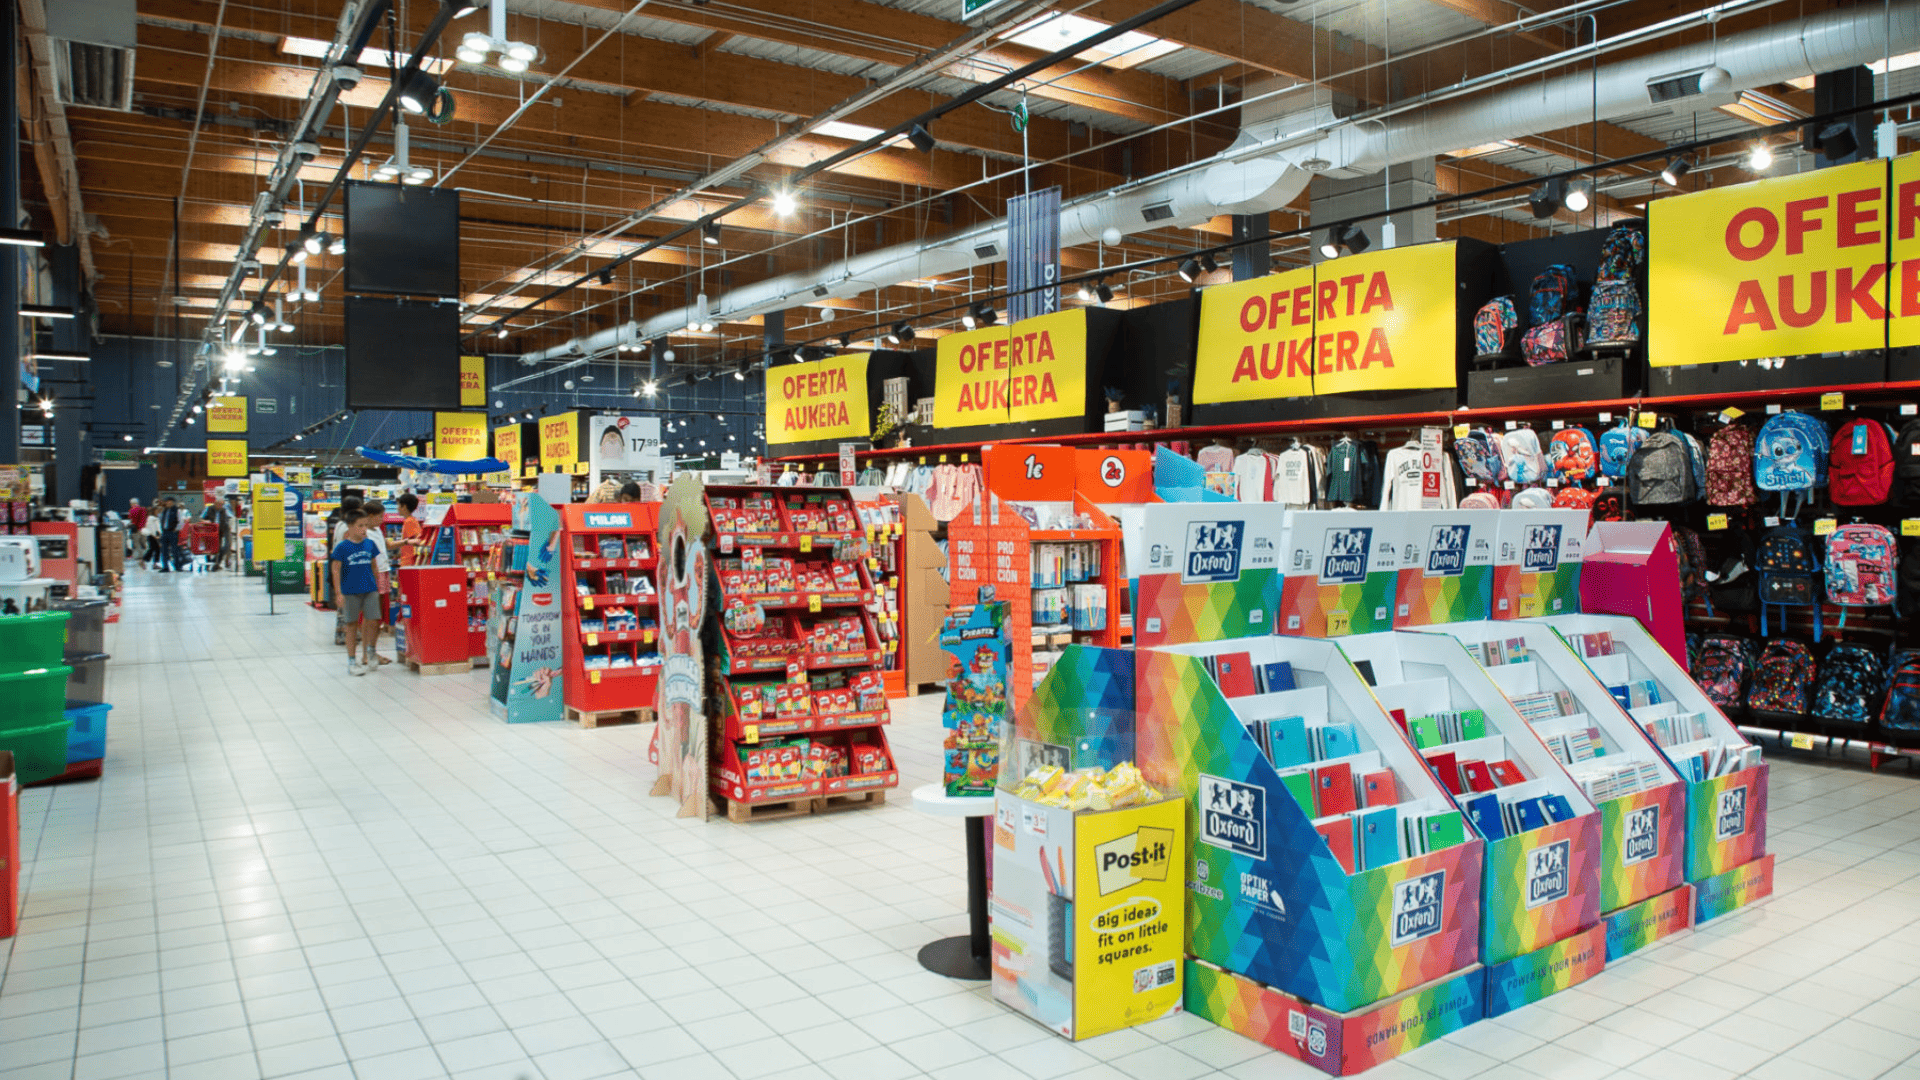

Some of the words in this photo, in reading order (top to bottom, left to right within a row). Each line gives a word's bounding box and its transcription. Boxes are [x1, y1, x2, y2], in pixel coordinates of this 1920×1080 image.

[1240, 270, 1394, 333] OFERTA
[959, 330, 1055, 373] OFERTA
[1231, 327, 1395, 383] AUKERA
[460, 372, 479, 380] RTA
[460, 382, 480, 390] ERA
[783, 367, 847, 400] OFERTA
[957, 373, 1058, 412] AUKERA
[784, 401, 850, 431] AUKERA
[441, 427, 481, 436] OFERTA
[441, 437, 481, 445] AUKERA
[1024, 454, 1044, 479] 1€
[589, 514, 627, 525] MILAN
[958, 540, 974, 554] PRO
[997, 541, 1014, 555] PRO
[958, 554, 971, 567] MO
[997, 555, 1011, 568] MO
[1192, 552, 1232, 574] Oxford
[1327, 556, 1361, 577] Oxford
[1431, 551, 1459, 569] Oxford
[1527, 550, 1553, 566] Oxford
[1210, 813, 1254, 845] Oxford
[1720, 812, 1742, 832] Oxford
[1629, 836, 1654, 857] Oxford
[1240, 872, 1268, 891] OPTIK
[1533, 874, 1562, 897] Oxford
[1241, 884, 1269, 903] PAPER
[1098, 912, 1119, 928] Big
[1124, 906, 1157, 922] ideas
[1400, 907, 1435, 935] Oxford
[1098, 933, 1113, 948] fit
[1118, 931, 1134, 943] on
[1139, 921, 1168, 938] little
[1098, 943, 1152, 965] squares.
[1507, 972, 1536, 992] POWER
[1548, 956, 1570, 976] YOUR
[1571, 947, 1595, 965] HANDS
[1400, 1014, 1424, 1033] YOUR
[1367, 1025, 1398, 1048] HANDS
